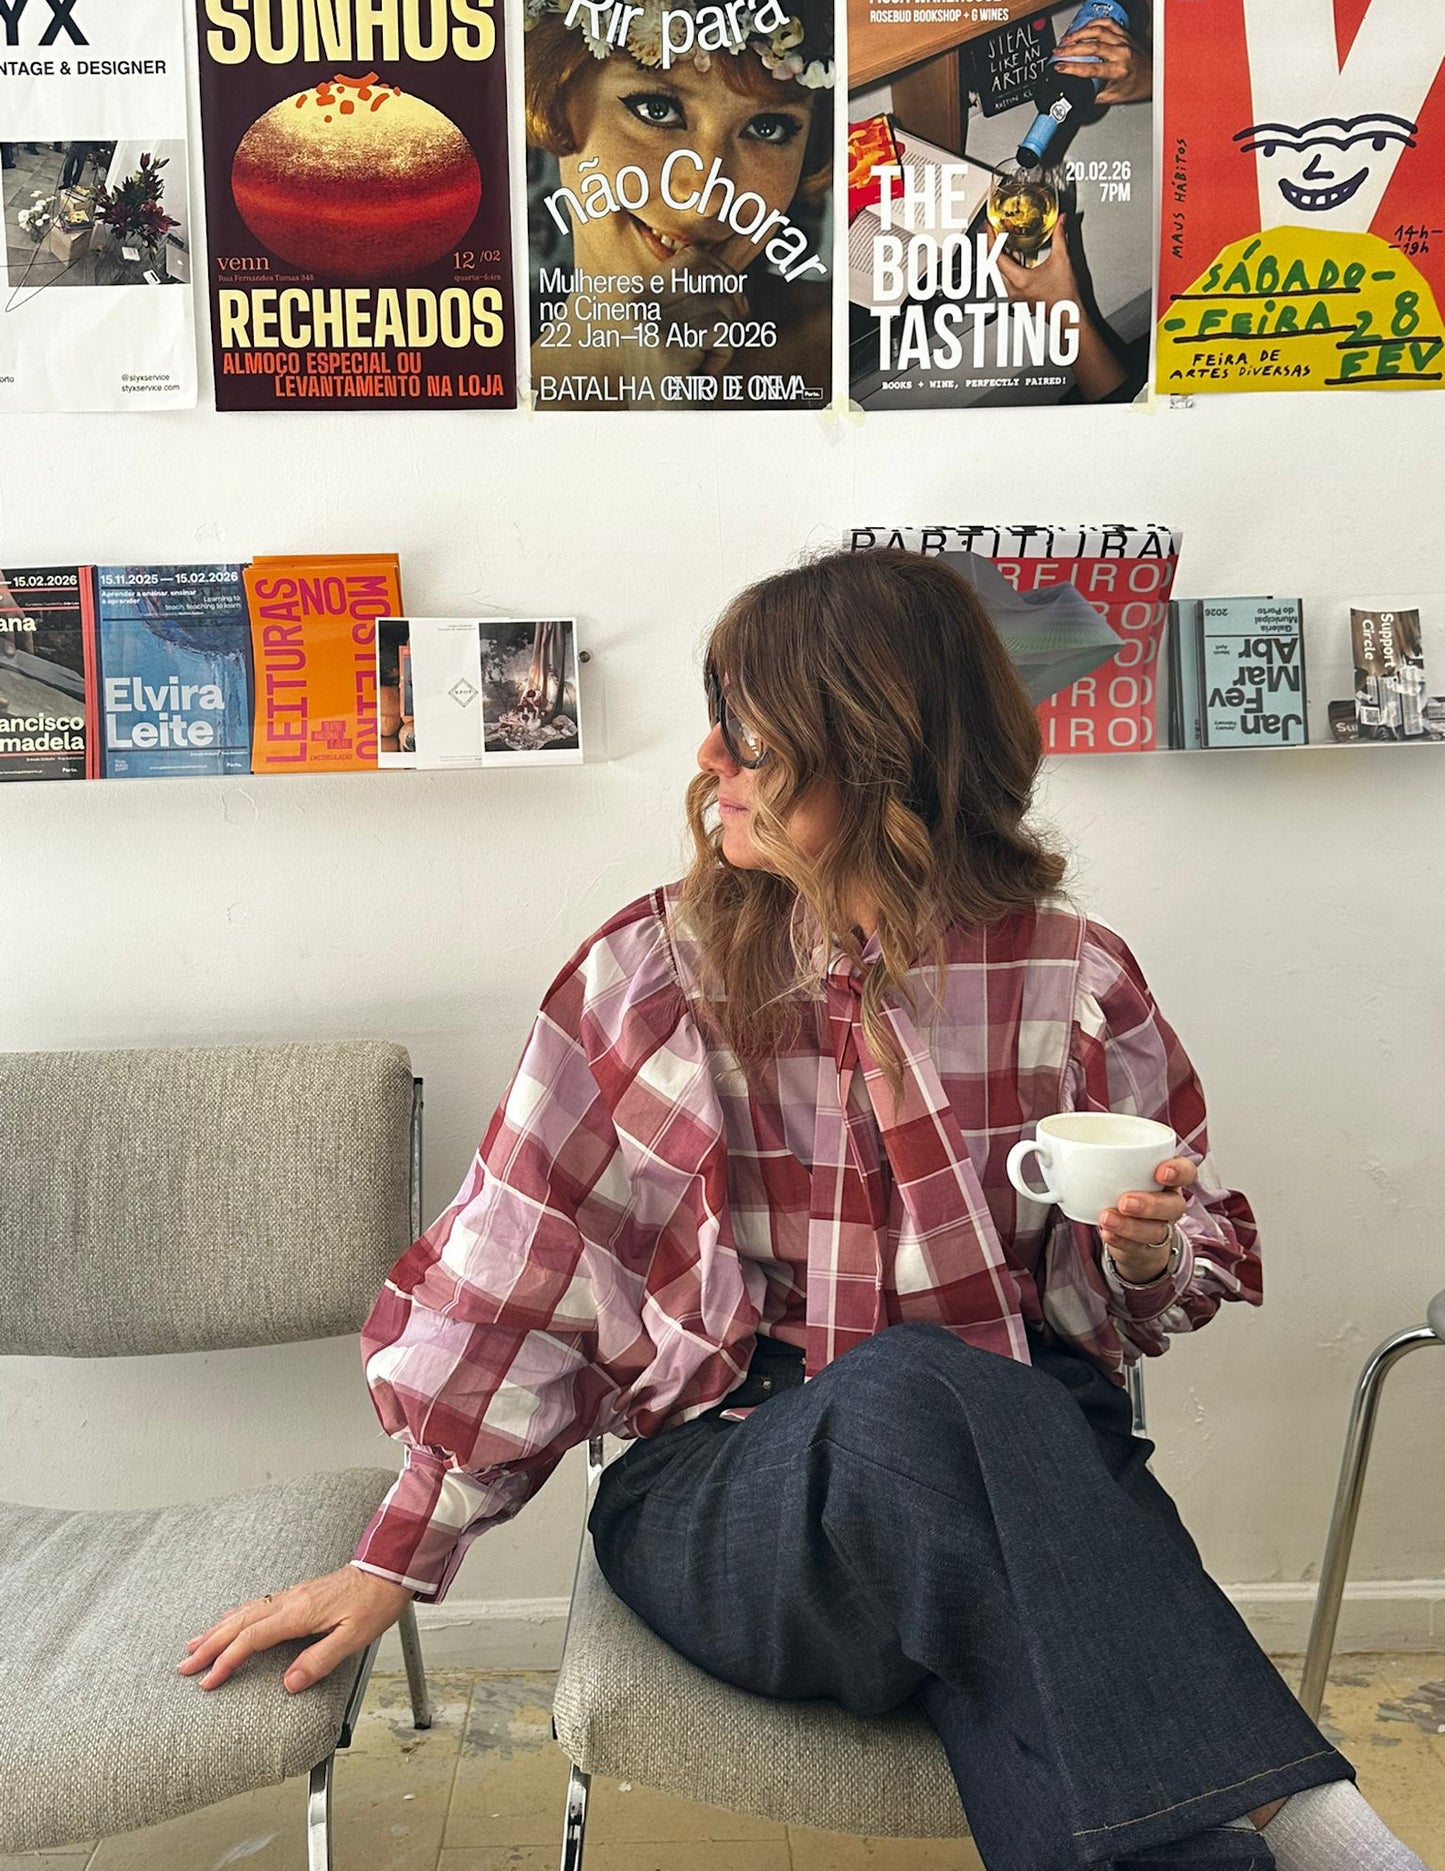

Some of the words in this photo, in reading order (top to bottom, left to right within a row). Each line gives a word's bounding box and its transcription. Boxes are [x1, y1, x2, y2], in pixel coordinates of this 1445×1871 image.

[870, 9, 912, 23] ROSEBUD
[913, 8, 961, 23] BOOKSHOP
[971, 8, 978, 21] G
[979, 8, 1009, 21] WINES
[204, 0, 496, 64] SONHOS
[564, 0, 645, 48] Rir
[661, 0, 790, 70] para
[988, 24, 1040, 59] STEAL
[60, 61, 71, 76] &
[77, 60, 166, 75] DESIGNER
[990, 52, 1019, 73] LIKE
[1024, 45, 1041, 63] AN
[991, 57, 1048, 92] ARTIST
[1065, 161, 1131, 182] 20.02.26
[871, 164, 969, 231] THE
[1099, 183, 1131, 202] 7PM
[543, 157, 650, 236] não
[660, 149, 828, 283] Chorar
[1171, 212, 1185, 259] MAUS
[217, 256, 270, 271] venn
[453, 251, 475, 269] 12
[480, 250, 501, 262] /02
[872, 232, 1010, 301] BOOK
[539, 268, 644, 294] Mulheres
[650, 275, 664, 294] e
[671, 268, 747, 294] Humor
[219, 288, 504, 348] RECHEADOS
[539, 302, 568, 320] no
[575, 296, 661, 321] Cinema
[539, 323, 571, 347] 22
[665, 322, 707, 347] Abr
[713, 322, 777, 347] 2026
[870, 300, 1080, 370] TASTING
[223, 352, 300, 377] ALMOÇO
[307, 352, 391, 374] ESPECIAL
[397, 351, 422, 374] OU
[1260, 350, 1281, 362] DE
[1340, 341, 1444, 379] FEV
[122, 374, 170, 383] @styxservice
[275, 375, 420, 397] LEVANTAMENTO
[427, 375, 453, 397] NA
[459, 374, 504, 397] LOJA
[882, 381, 912, 390] BOOKS
[929, 380, 959, 389] WINE,
[965, 378, 1020, 388] PERFECTLY
[1025, 377, 1066, 386] PAIRED!
[1169, 368, 1229, 379] ARTES
[122, 384, 180, 393] styxservice.com
[540, 375, 655, 401] BATALHA
[13, 575, 78, 587] 15.02.2026
[100, 574, 158, 585] 15.11.2025
[175, 572, 238, 583] 15.02.2026
[101, 590, 135, 598] Aprender
[107, 598, 140, 606] aprender
[203, 595, 232, 603] Learning
[298, 576, 347, 616] NO
[1205, 608, 1228, 616] 2026
[1255, 616, 1297, 624] Municipal
[1257, 607, 1281, 615] Porto
[1238, 638, 1298, 665] Abr
[1362, 619, 1375, 660] Circle
[1378, 613, 1396, 668] Support
[255, 578, 308, 763] LEITURAS
[1232, 665, 1300, 692] Mar
[105, 676, 225, 712] Elvira
[1208, 687, 1263, 714] Fev
[0, 713, 84, 732] ancisco
[106, 712, 214, 748] Leite
[1240, 713, 1302, 741] Jan
